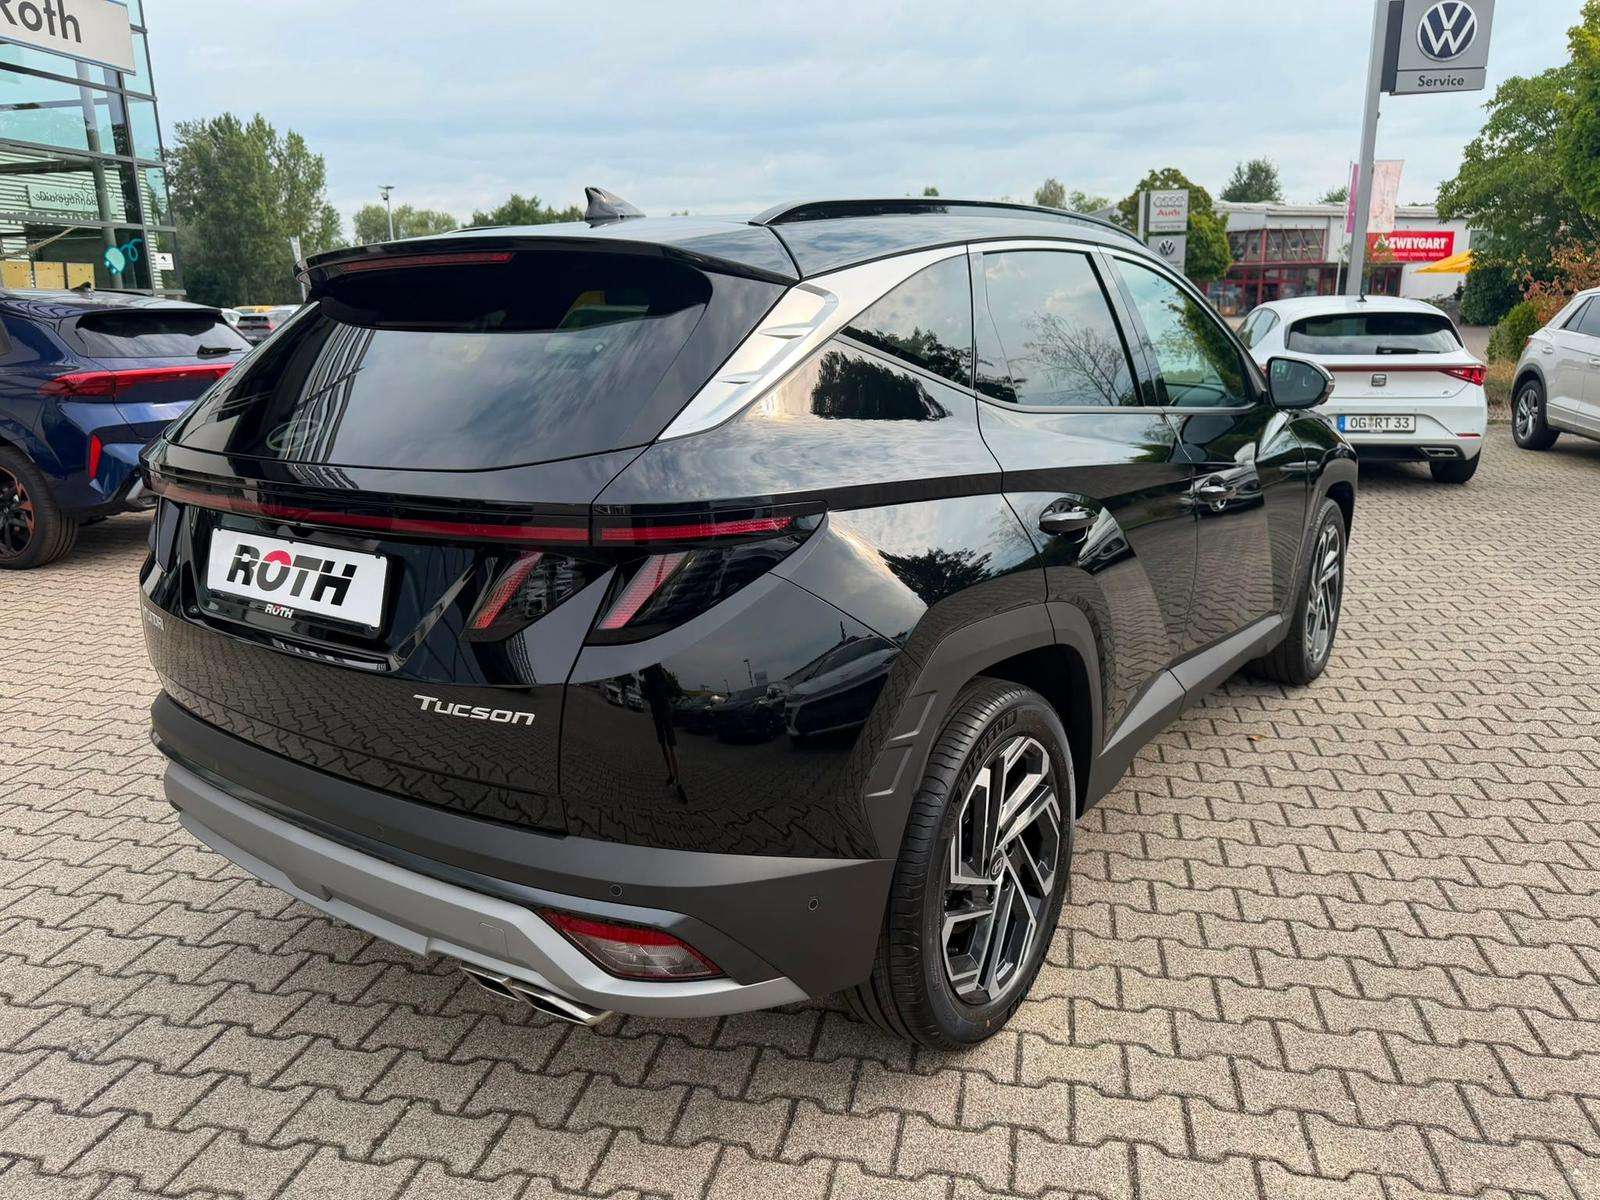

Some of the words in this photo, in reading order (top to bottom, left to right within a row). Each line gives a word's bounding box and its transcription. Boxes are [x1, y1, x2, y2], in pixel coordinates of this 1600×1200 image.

[1418, 75, 1465, 87] Service
[1156, 208, 1181, 217] Audi
[1389, 237, 1446, 249] ZWEYGART
[1350, 417, 1367, 428] OG
[1375, 417, 1391, 428] RT
[1394, 417, 1410, 428] 33
[226, 543, 357, 607] ROTH
[264, 603, 294, 619] ROTH
